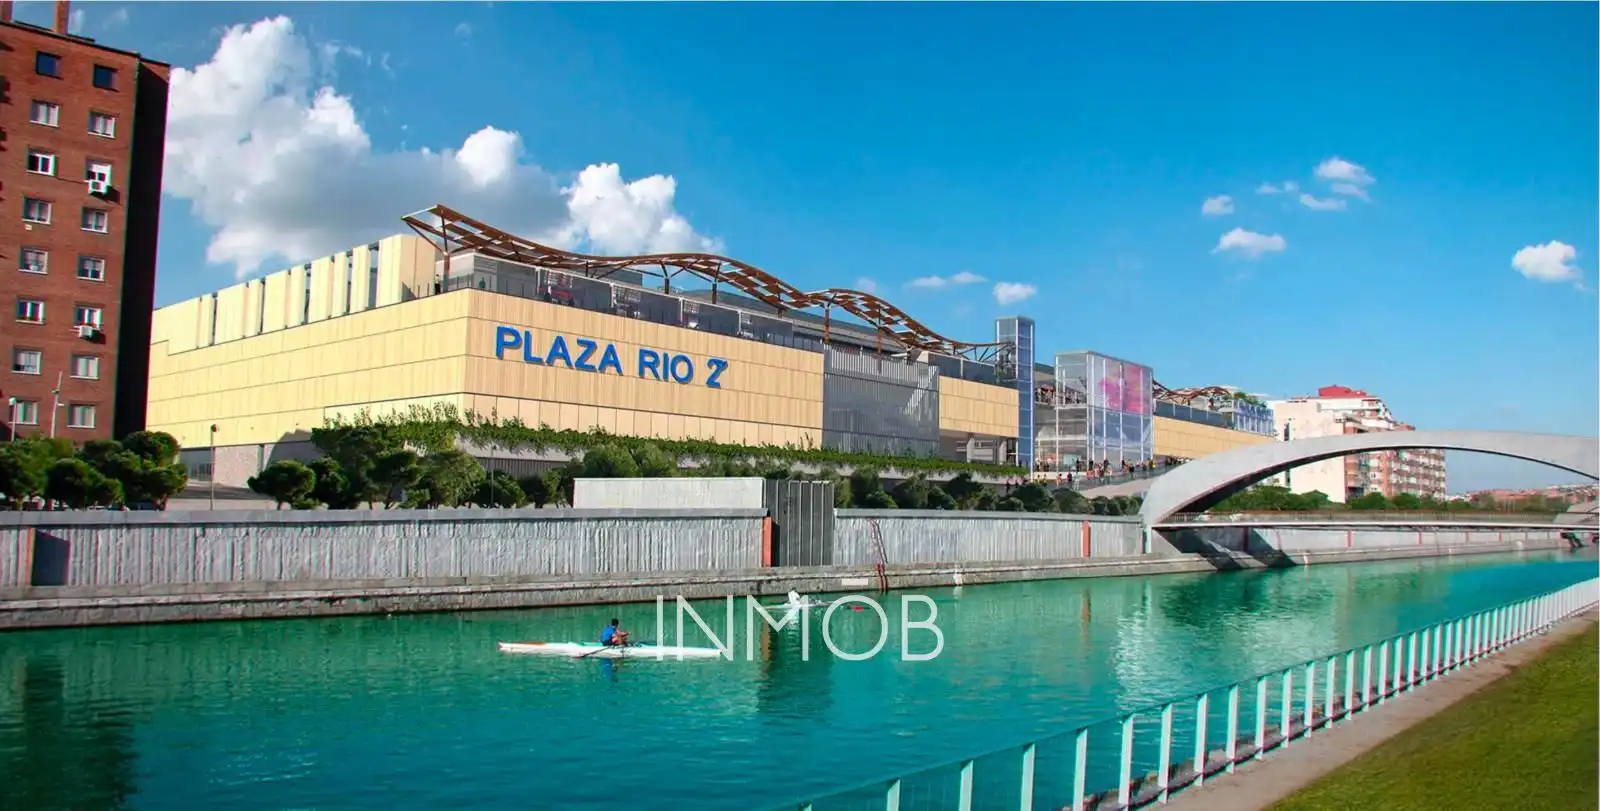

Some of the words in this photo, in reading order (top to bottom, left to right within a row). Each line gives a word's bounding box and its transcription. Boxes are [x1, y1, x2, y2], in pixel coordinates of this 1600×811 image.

[496, 325, 623, 375] PLAZA
[639, 349, 694, 384] RIO
[706, 358, 729, 388] 2
